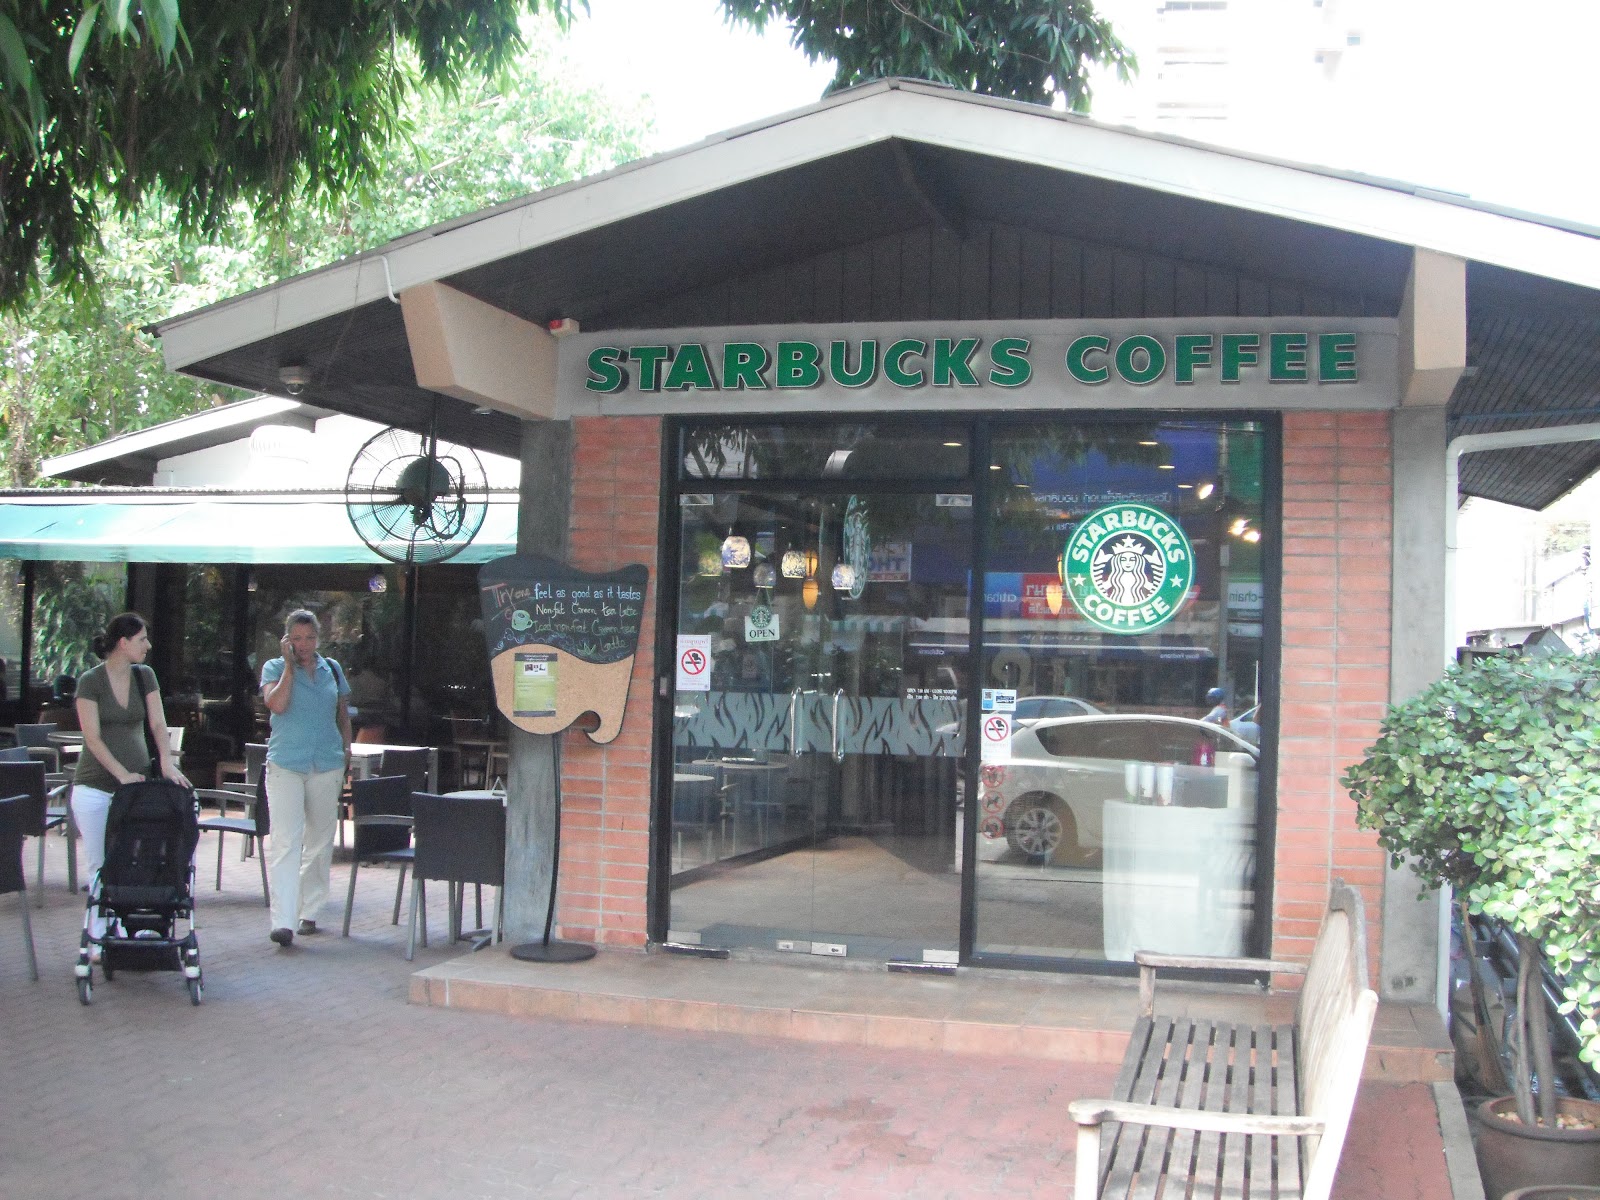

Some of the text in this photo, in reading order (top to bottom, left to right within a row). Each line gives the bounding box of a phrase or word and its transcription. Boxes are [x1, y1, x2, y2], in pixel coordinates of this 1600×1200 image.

[584, 333, 1358, 392] STARBUCKS COFFEE
[1072, 510, 1185, 563] STARBUCKS
[534, 583, 552, 600] feel
[556, 588, 565, 598] as
[571, 586, 590, 604] good
[593, 588, 603, 598] as
[607, 586, 613, 599] it
[617, 586, 641, 600] tastes
[1083, 594, 1170, 627] COFFEE
[749, 629, 775, 639] OPEN
